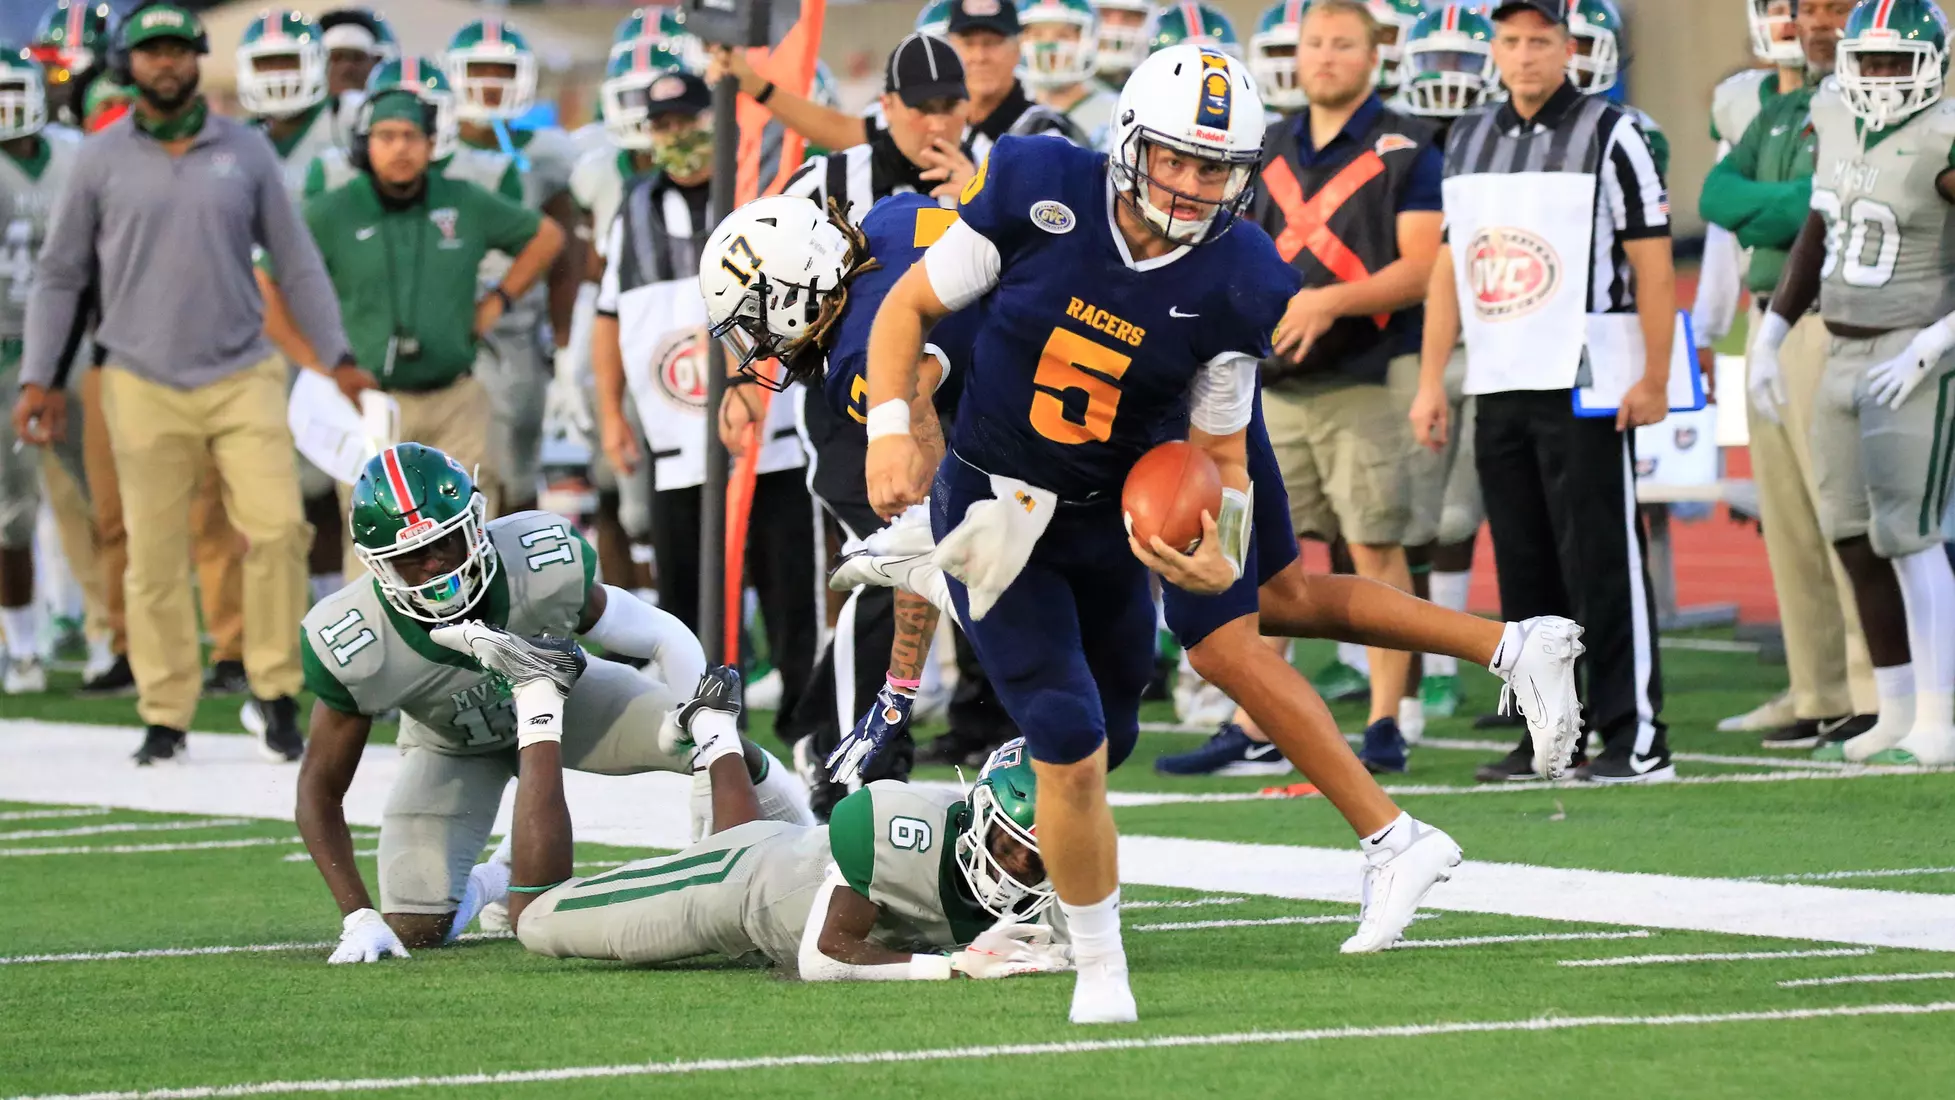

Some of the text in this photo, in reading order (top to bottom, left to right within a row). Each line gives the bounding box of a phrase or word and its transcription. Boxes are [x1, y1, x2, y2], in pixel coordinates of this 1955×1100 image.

[1195, 129, 1226, 142] Riddell
[1040, 209, 1065, 225] OVC
[720, 234, 765, 288] 17
[1065, 296, 1146, 347] RACERS
[675, 356, 708, 390] OV
[1029, 326, 1133, 445] 5
[518, 524, 576, 573] 11
[318, 608, 378, 668] 11
[888, 815, 932, 853] 6
